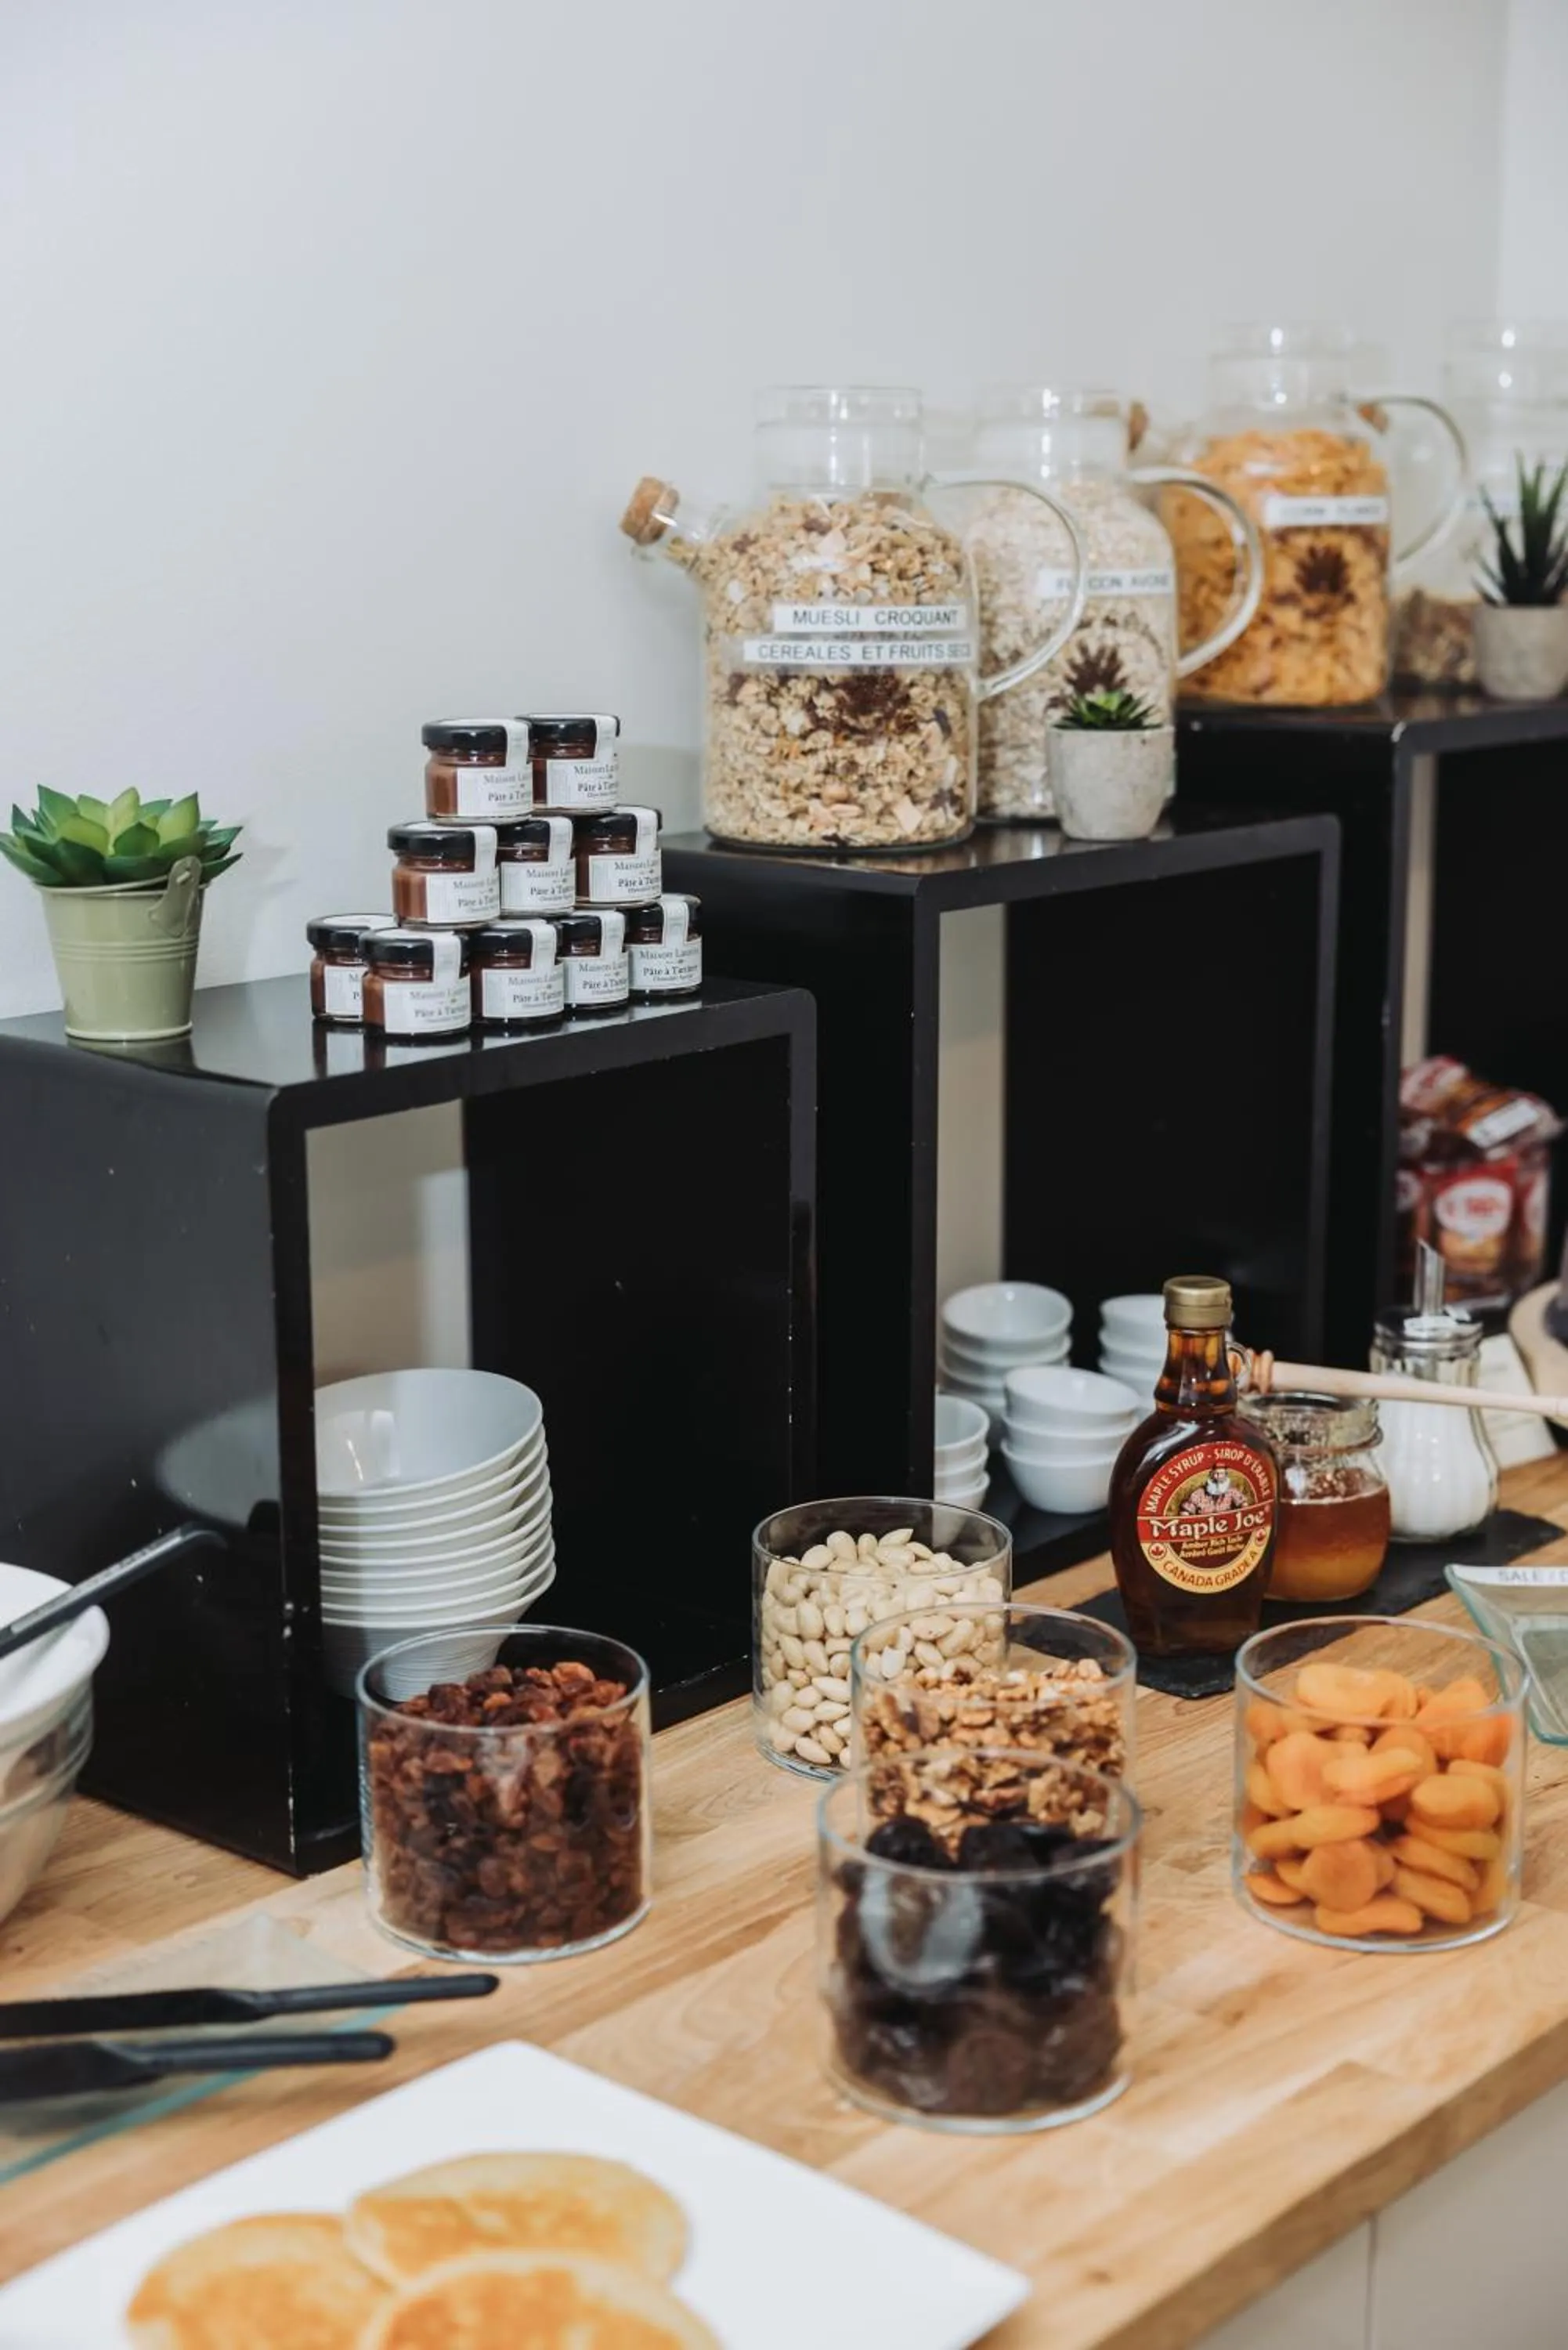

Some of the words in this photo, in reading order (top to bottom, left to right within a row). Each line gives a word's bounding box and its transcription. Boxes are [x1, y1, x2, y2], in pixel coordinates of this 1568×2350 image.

[793, 609, 860, 626] MUESLI
[874, 609, 958, 626] CROQUANT
[862, 644, 883, 660] ET
[889, 643, 945, 660] FRUITS
[639, 950, 674, 960] Maison
[1145, 1474, 1172, 1513] MAPLE
[1168, 1452, 1205, 1478] SYRUP
[1214, 1448, 1245, 1461] SIROP
[1149, 1516, 1229, 1540] Maple
[1234, 1510, 1265, 1531] Joe
[1162, 1562, 1214, 1587] CANADA
[1215, 1559, 1252, 1585] GRADE
[1249, 1549, 1259, 1561] A
